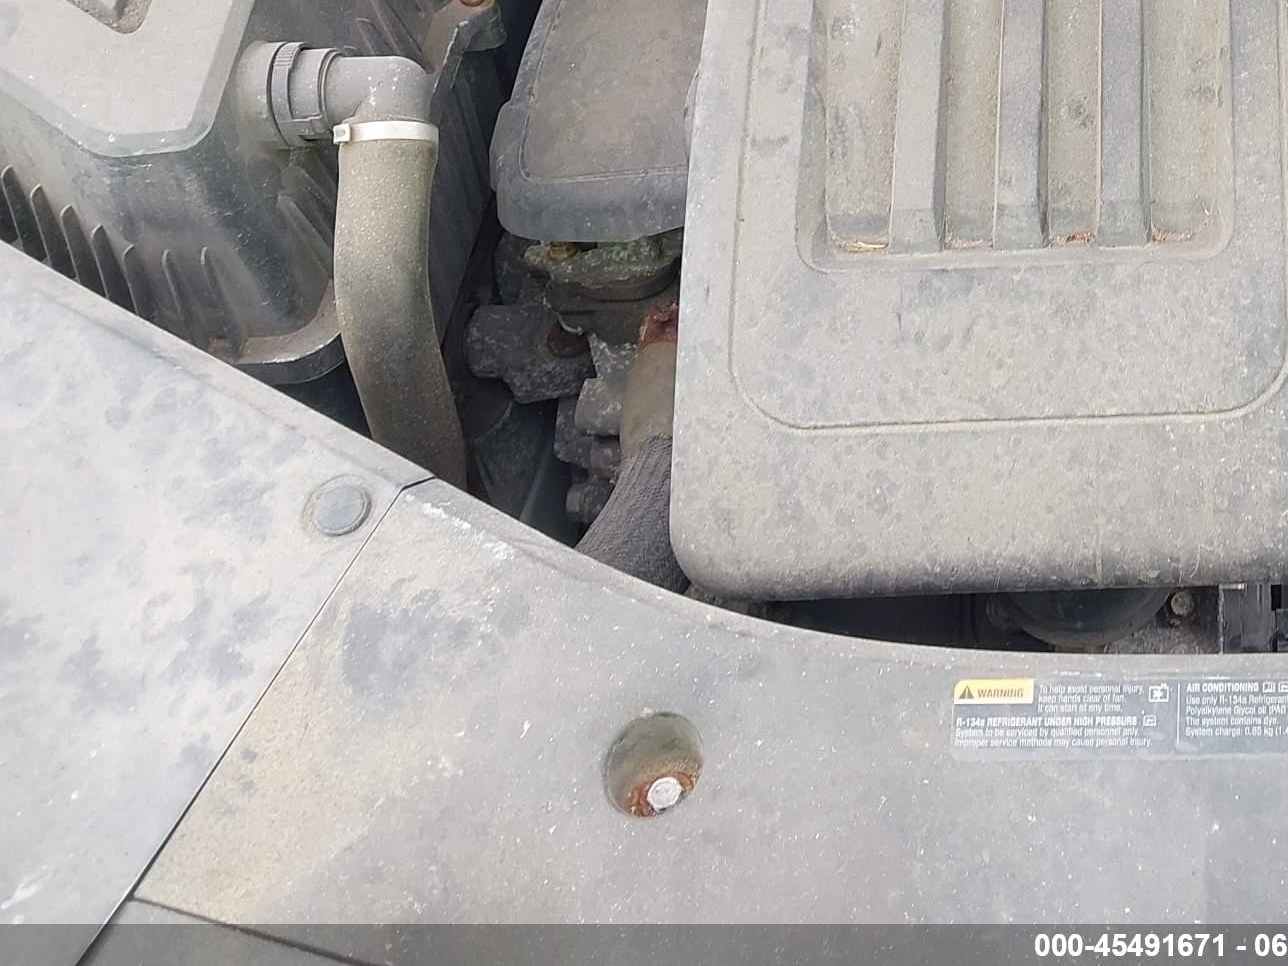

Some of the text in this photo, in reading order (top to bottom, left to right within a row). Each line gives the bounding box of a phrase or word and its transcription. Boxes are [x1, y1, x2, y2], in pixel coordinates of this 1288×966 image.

[1186, 682, 1259, 693] AIR CONDITIONING
[977, 688, 1024, 698] WARNING
[1219, 695, 1247, 704] R-134a
[956, 716, 1137, 727] R-134a REFRIGERANT UNDER HIGH PRESSURE
